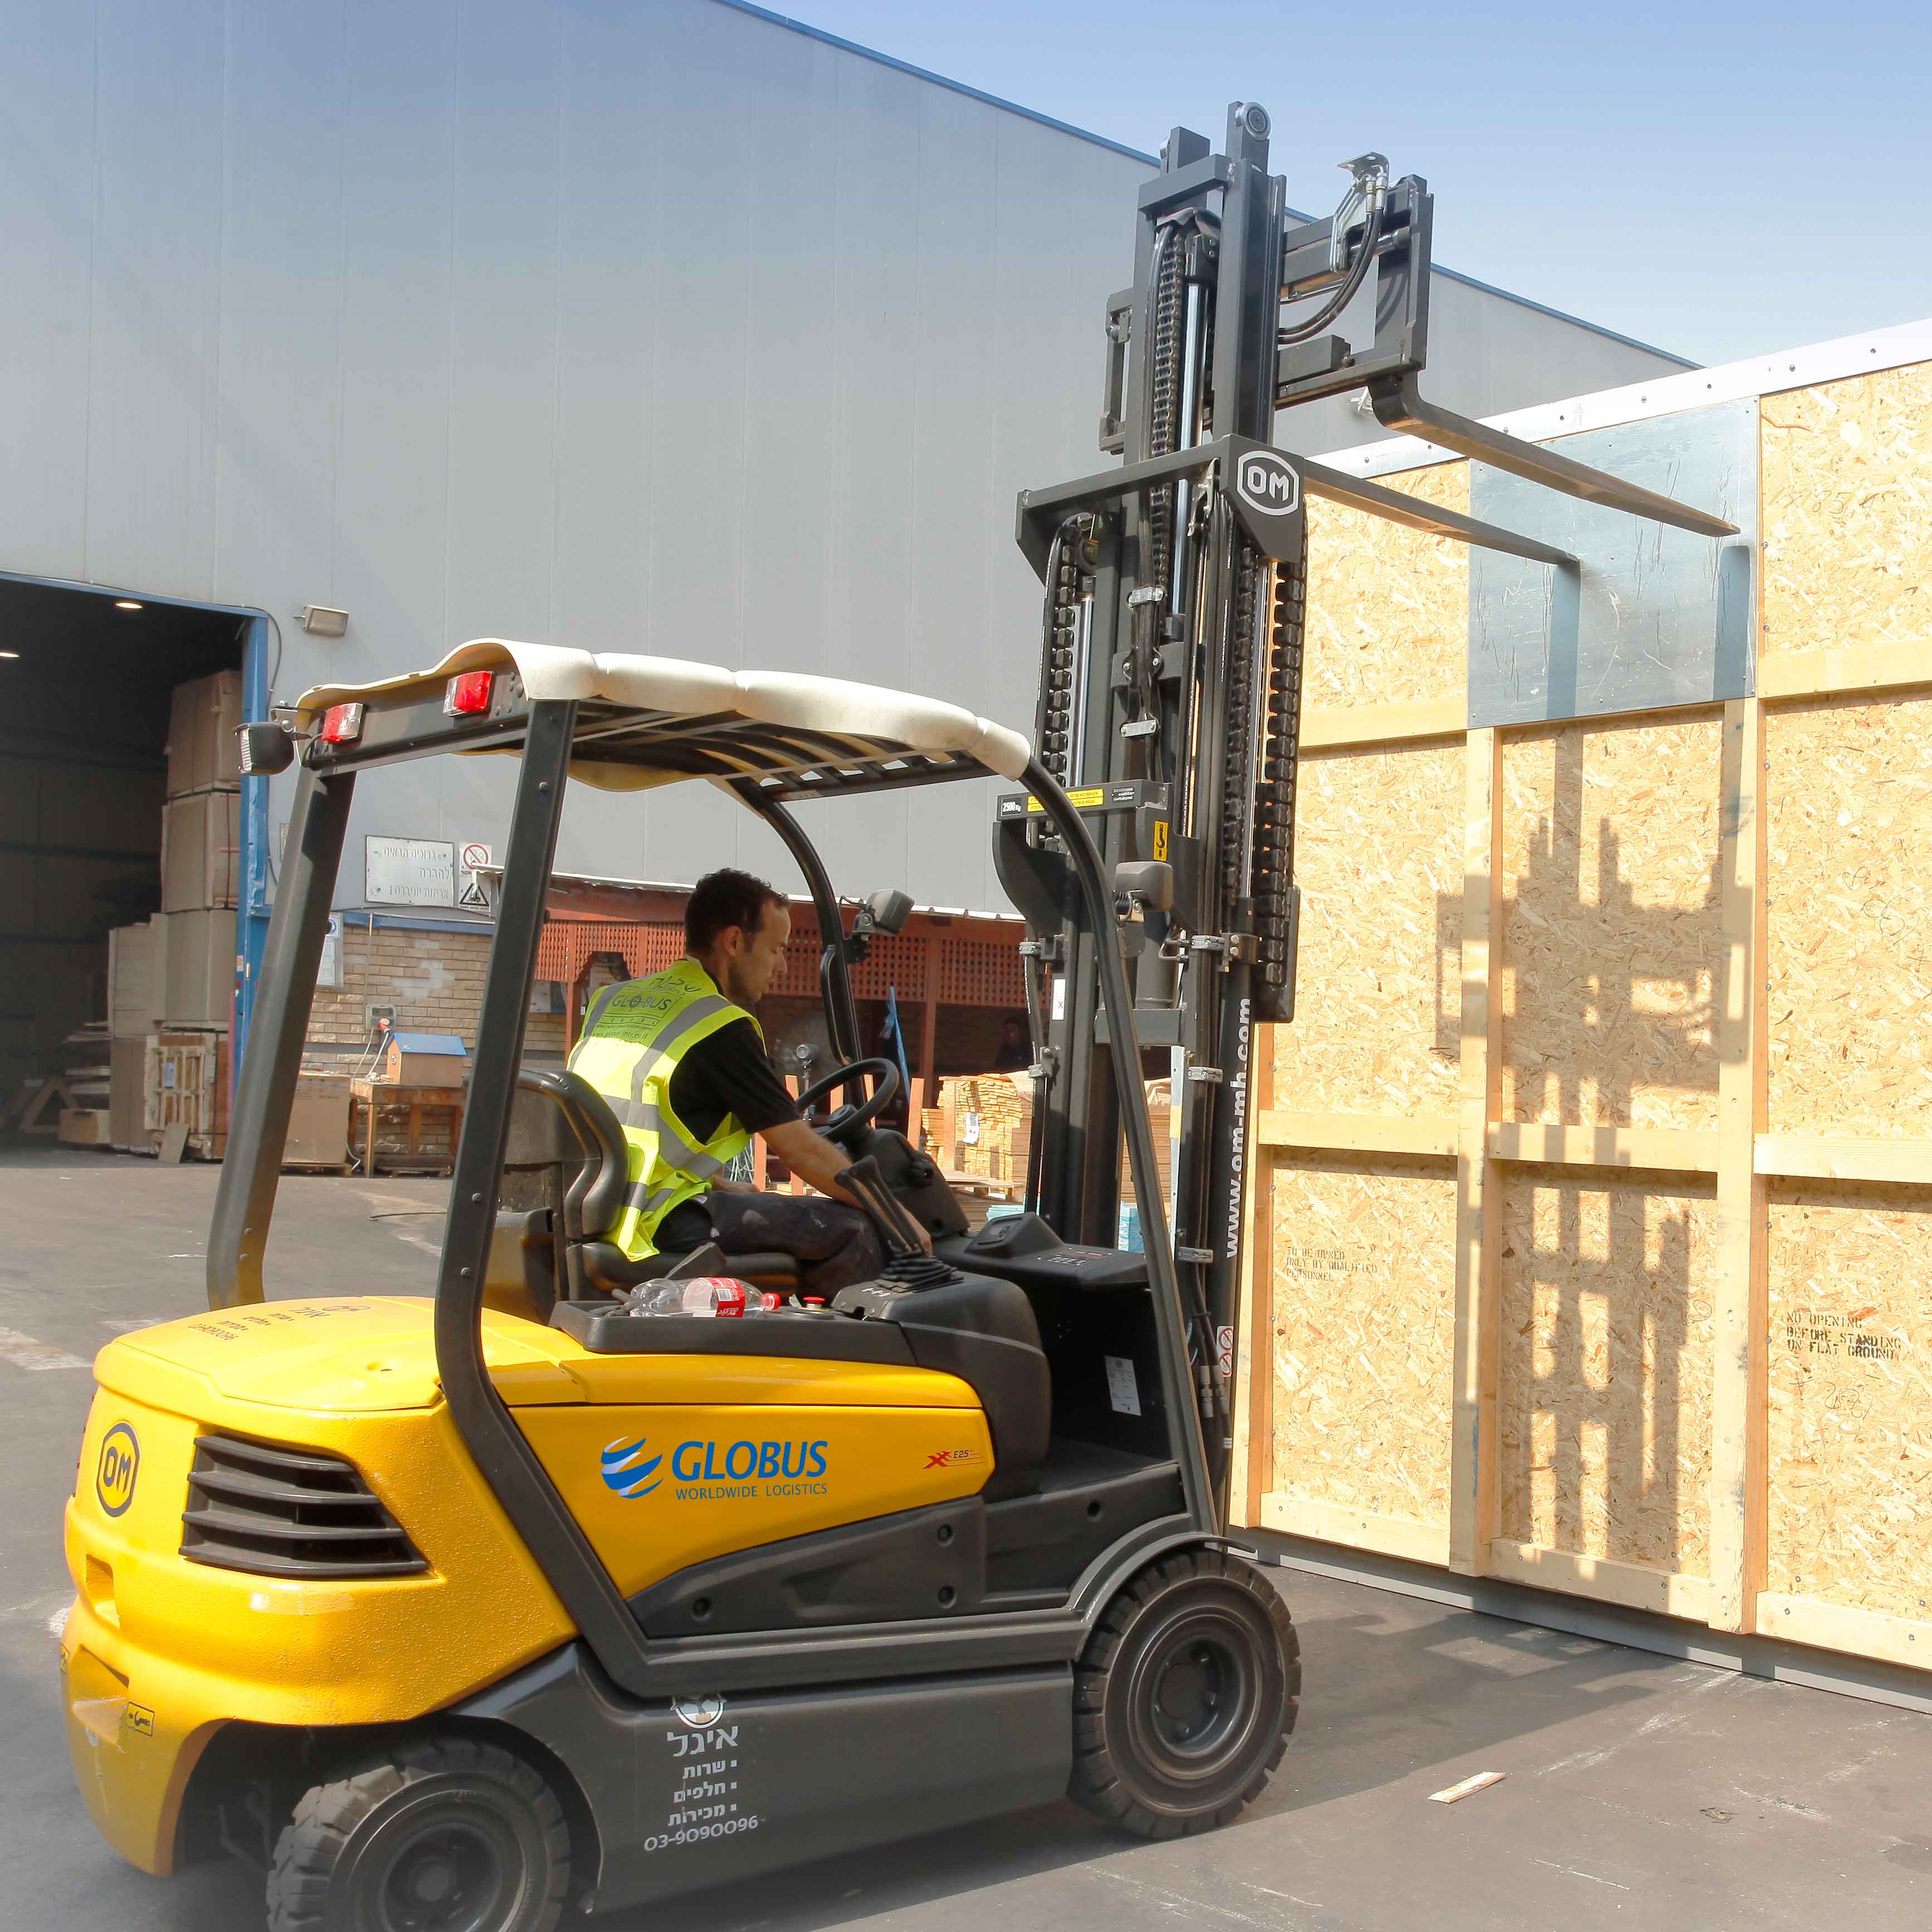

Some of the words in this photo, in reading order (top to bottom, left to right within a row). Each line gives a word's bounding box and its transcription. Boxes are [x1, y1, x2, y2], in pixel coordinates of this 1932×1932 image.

[1248, 466, 1289, 501] OM
[612, 995, 672, 1011] GLOBUS
[1227, 998, 1251, 1258] www.om-mh.com
[1313, 1260, 1324, 1269] BY
[1787, 1311, 1801, 1324] NO
[1809, 1313, 1862, 1329] OPENING
[1787, 1326, 1832, 1343] BEFORE
[1840, 1332, 1901, 1349] STANDING
[1787, 1339, 1802, 1351] ON
[1809, 1341, 1839, 1355] FLAT
[1848, 1345, 1895, 1360] GROUND
[104, 1446, 131, 1494] OM
[671, 1440, 828, 1482] GLOBUS
[675, 1485, 758, 1500] WORLDWIDE
[766, 1483, 827, 1497] LOGISTICS
[667, 1725, 739, 1757] איגל
[682, 1760, 726, 1779] שרות
[674, 1781, 726, 1803] חלפים
[668, 1804, 725, 1826] מכירות
[644, 1815, 758, 1851] 03-9090096
